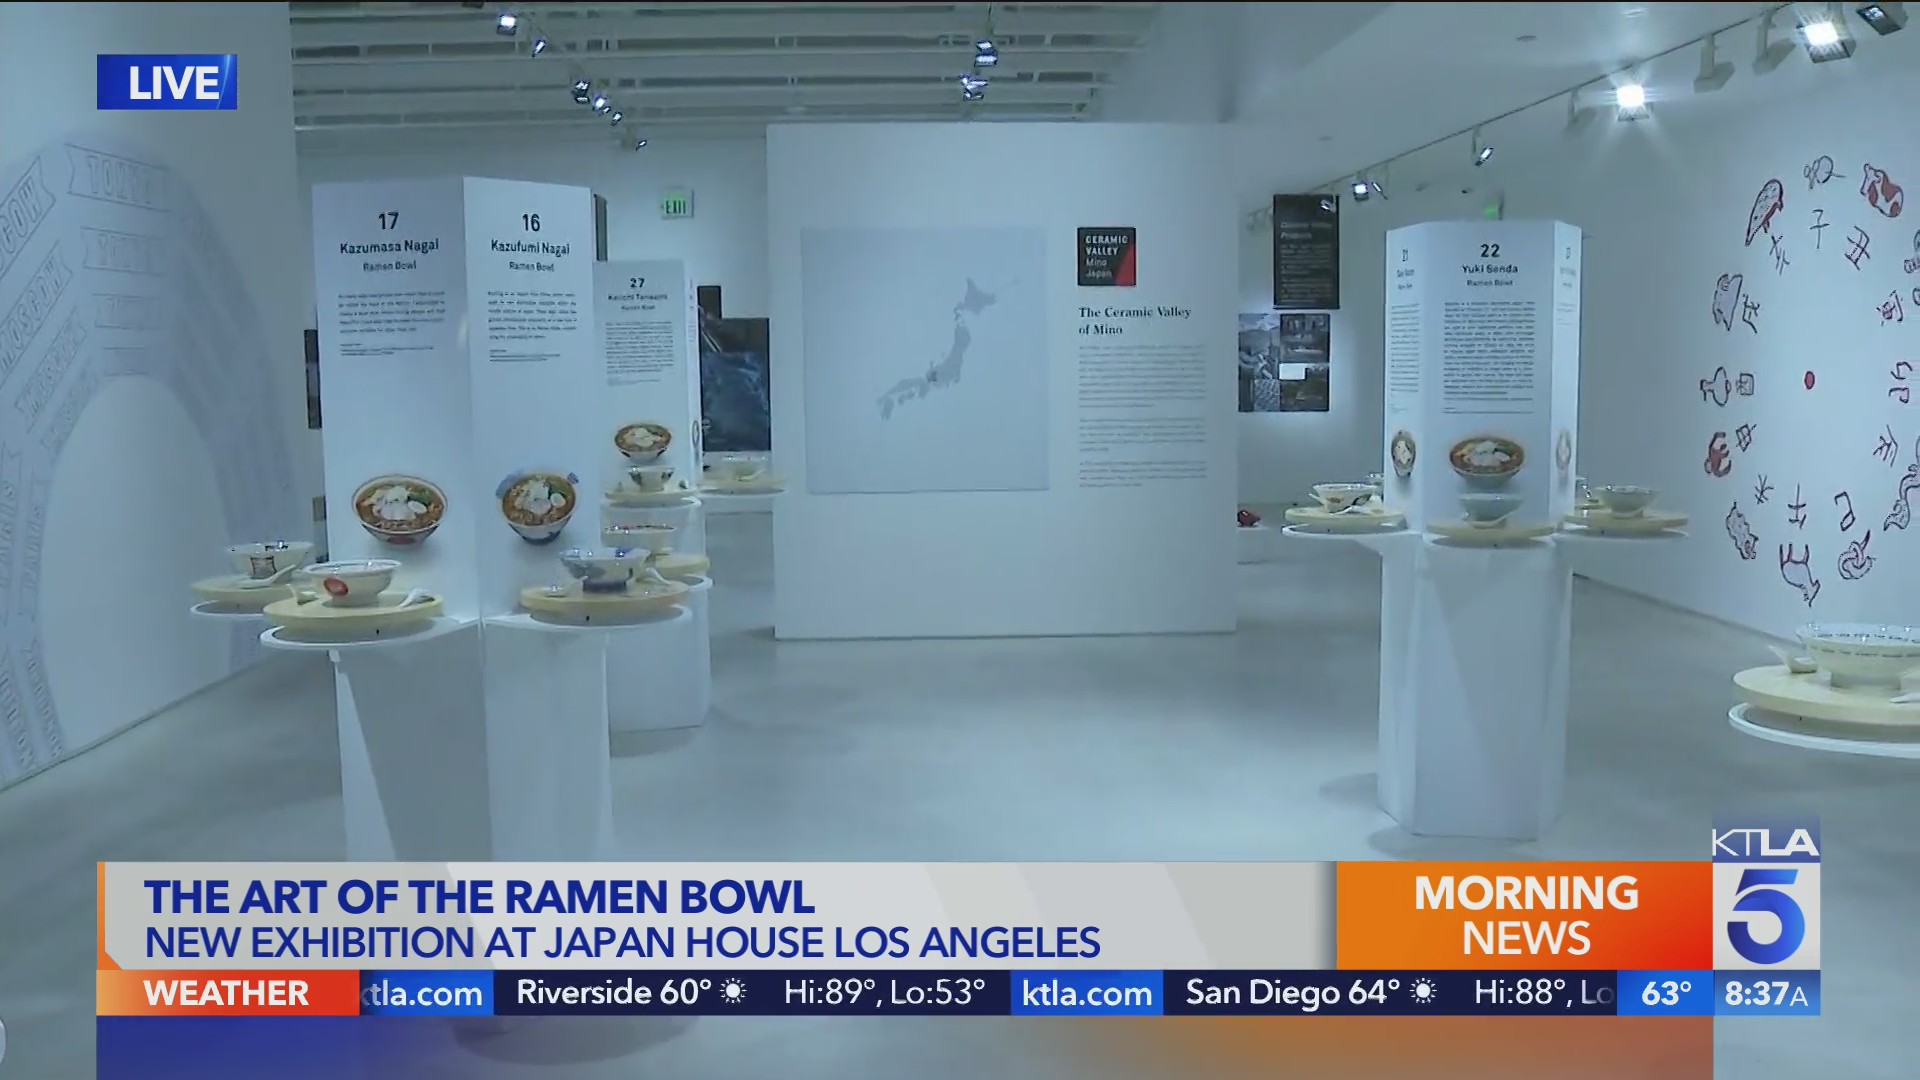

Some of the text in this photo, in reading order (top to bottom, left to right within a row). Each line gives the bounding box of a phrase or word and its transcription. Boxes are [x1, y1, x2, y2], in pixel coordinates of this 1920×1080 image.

[378, 211, 399, 230] 17
[522, 213, 541, 232] 16
[1085, 235, 1128, 244] CERAMIC
[340, 238, 439, 255] Kazumasa Nagai
[491, 238, 570, 258] Kazufumi Nagai
[1085, 246, 1119, 256] VALLEY
[1480, 243, 1500, 258] 22
[363, 262, 393, 272] Ramen
[509, 261, 535, 271] Ramen
[1086, 257, 1108, 266] Mino
[1462, 264, 1518, 274] Yuki Senda
[630, 277, 645, 288] 27
[1079, 305, 1191, 319] The Ceramic Valley
[1078, 323, 1123, 335] of Mino
